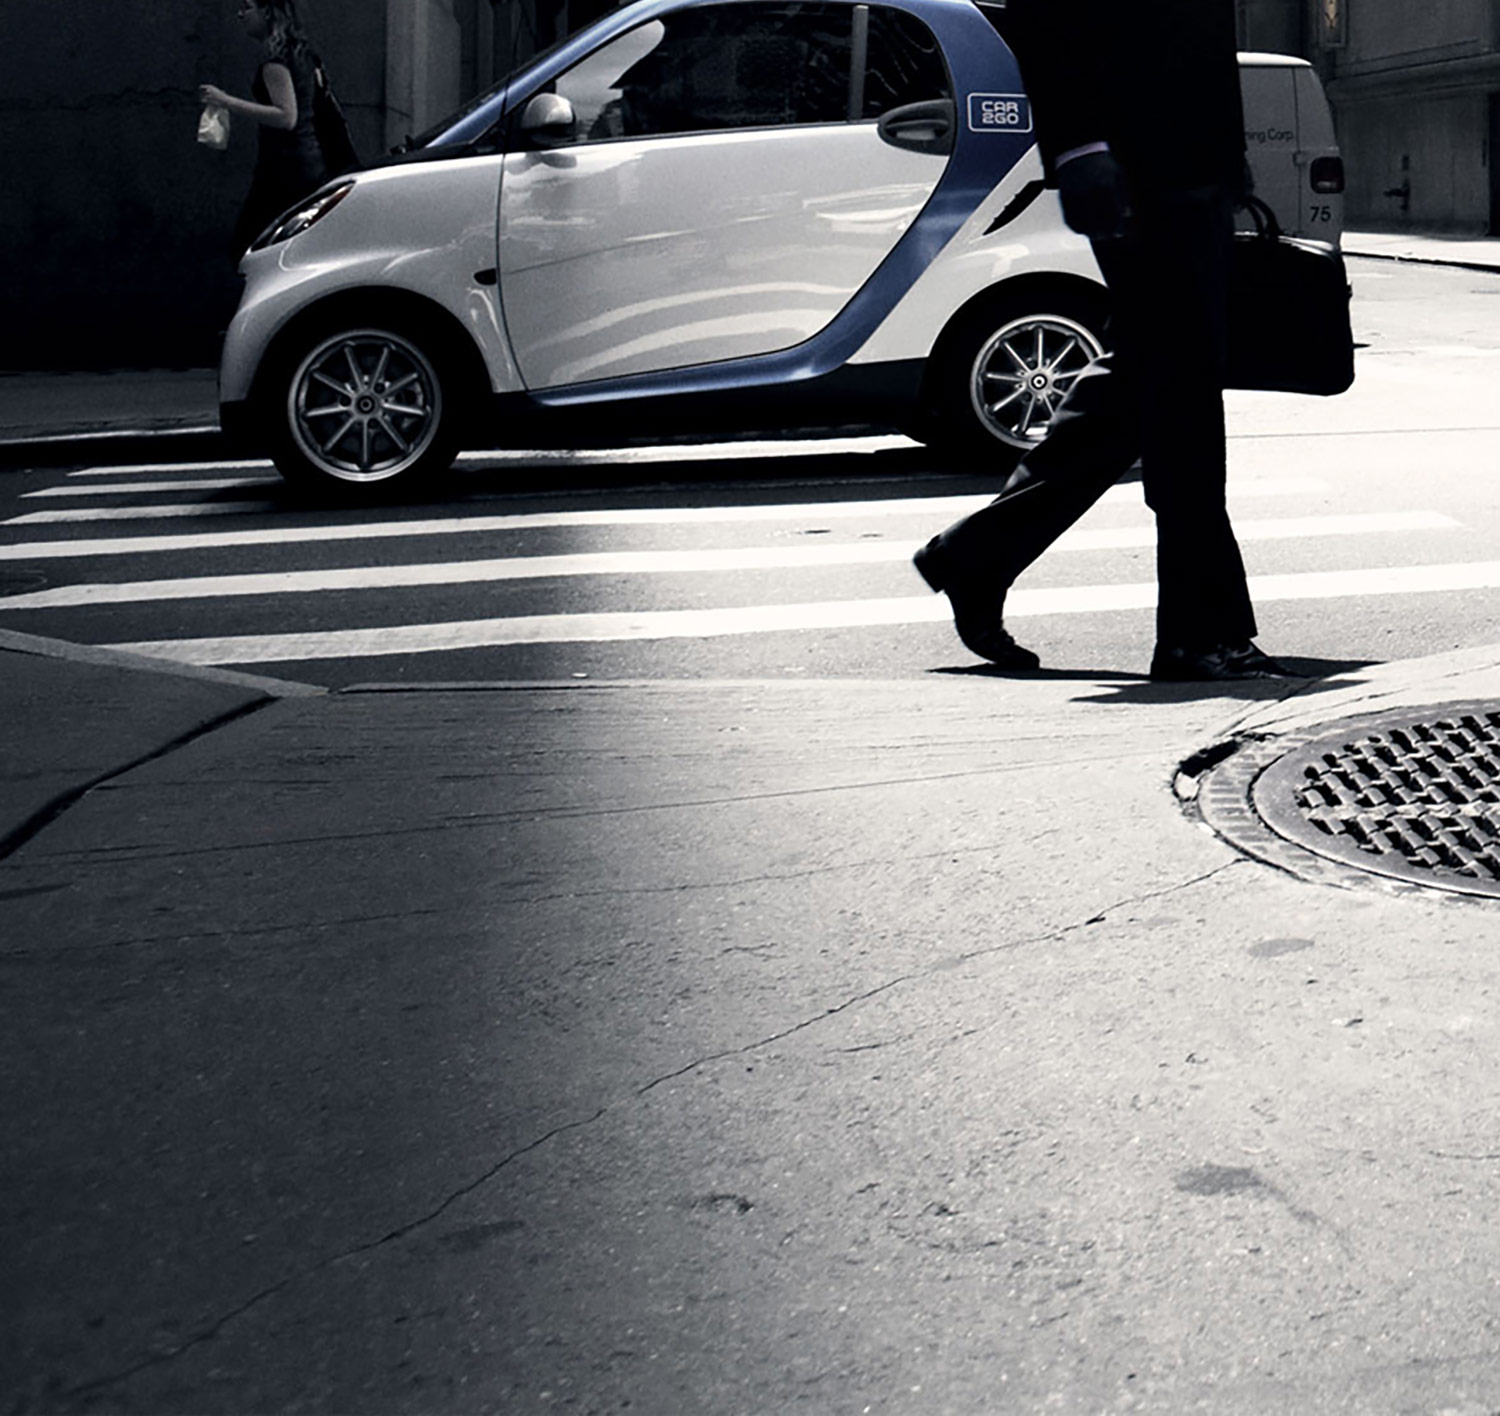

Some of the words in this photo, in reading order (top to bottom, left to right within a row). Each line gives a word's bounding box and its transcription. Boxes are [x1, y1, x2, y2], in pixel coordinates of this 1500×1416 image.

[981, 100, 1020, 114] CAR
[981, 112, 1020, 125] 2GO
[1310, 205, 1332, 223] 75
